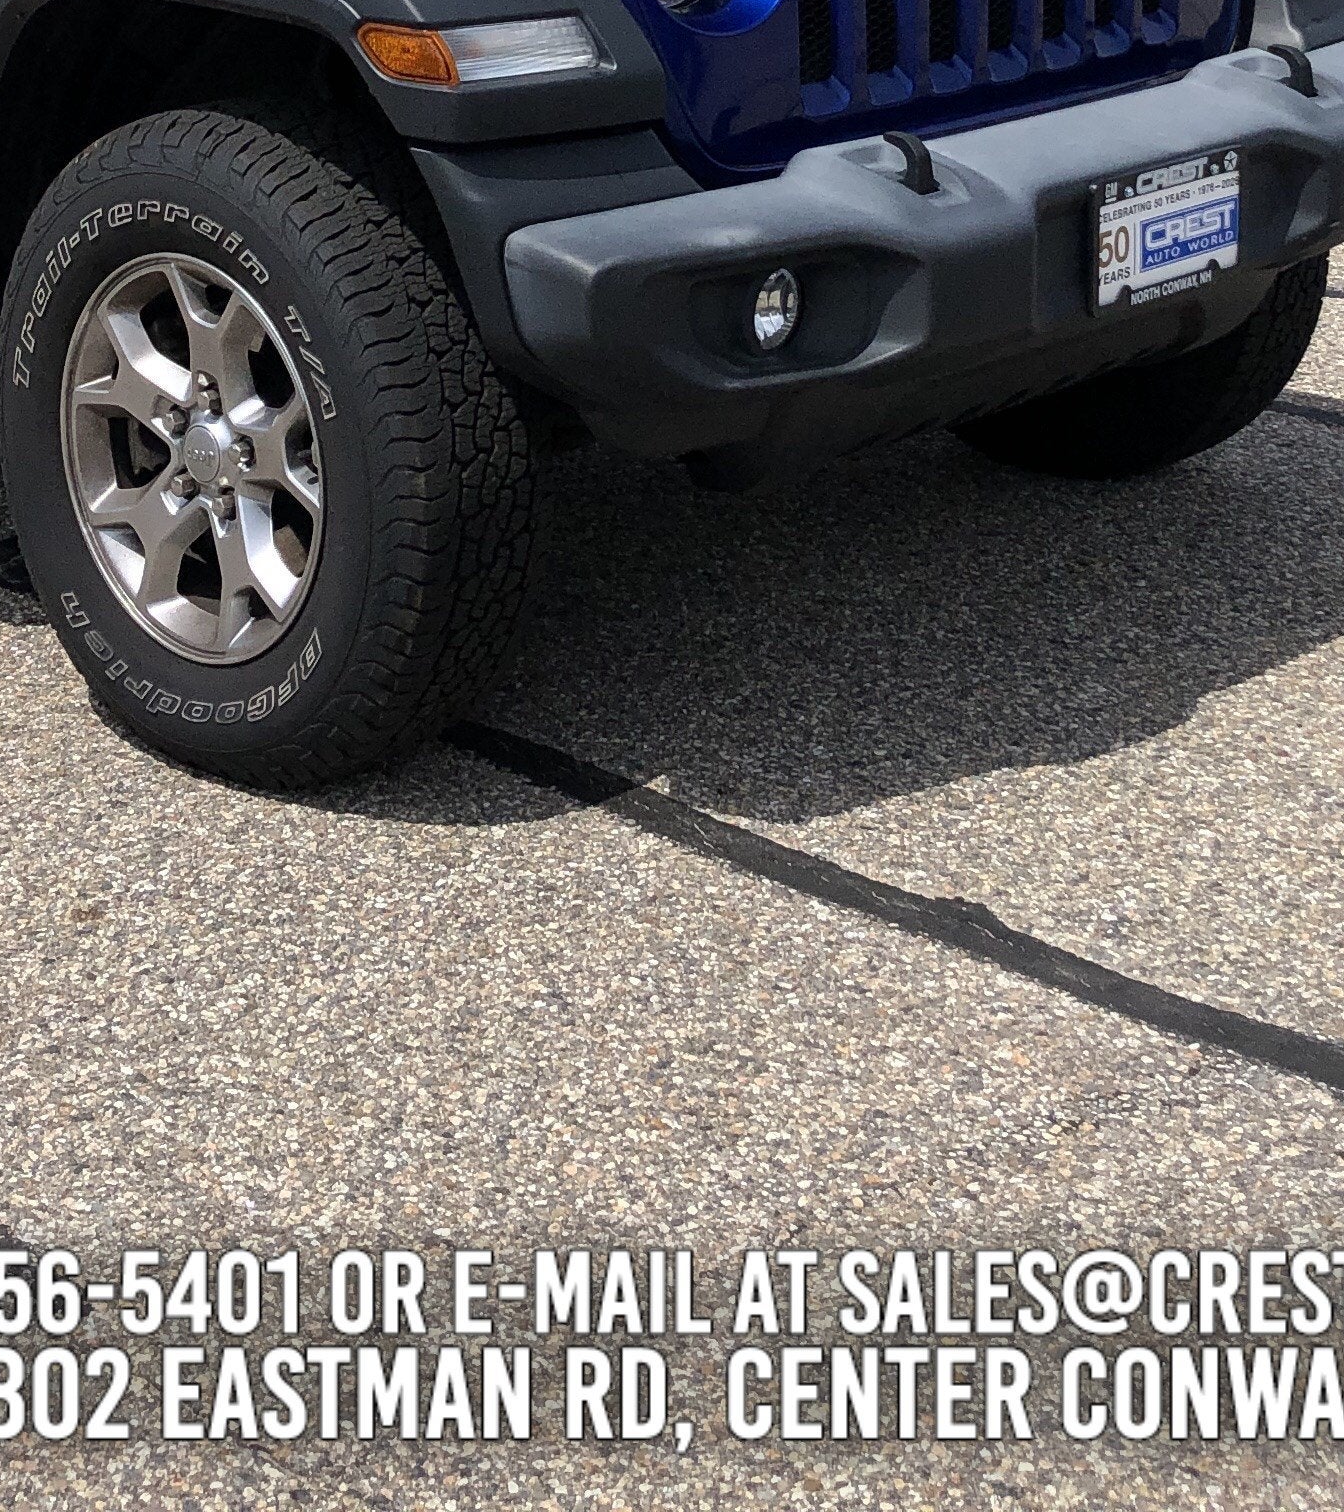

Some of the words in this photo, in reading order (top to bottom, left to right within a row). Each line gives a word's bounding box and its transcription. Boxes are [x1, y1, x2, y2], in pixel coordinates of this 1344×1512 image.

[1136, 156, 1209, 195] CREST
[1164, 189, 1191, 204] YEARS
[1099, 225, 1130, 268] 50
[1145, 200, 1236, 252] CREST
[1145, 246, 1181, 266] AUTO
[1187, 230, 1234, 252] WORLD
[1130, 285, 1161, 306] NORTH
[1199, 269, 1213, 284] NH
[13, 200, 270, 389] Trail-Terrain
[284, 305, 337, 420] T/A
[60, 591, 323, 724] BFGoodrich
